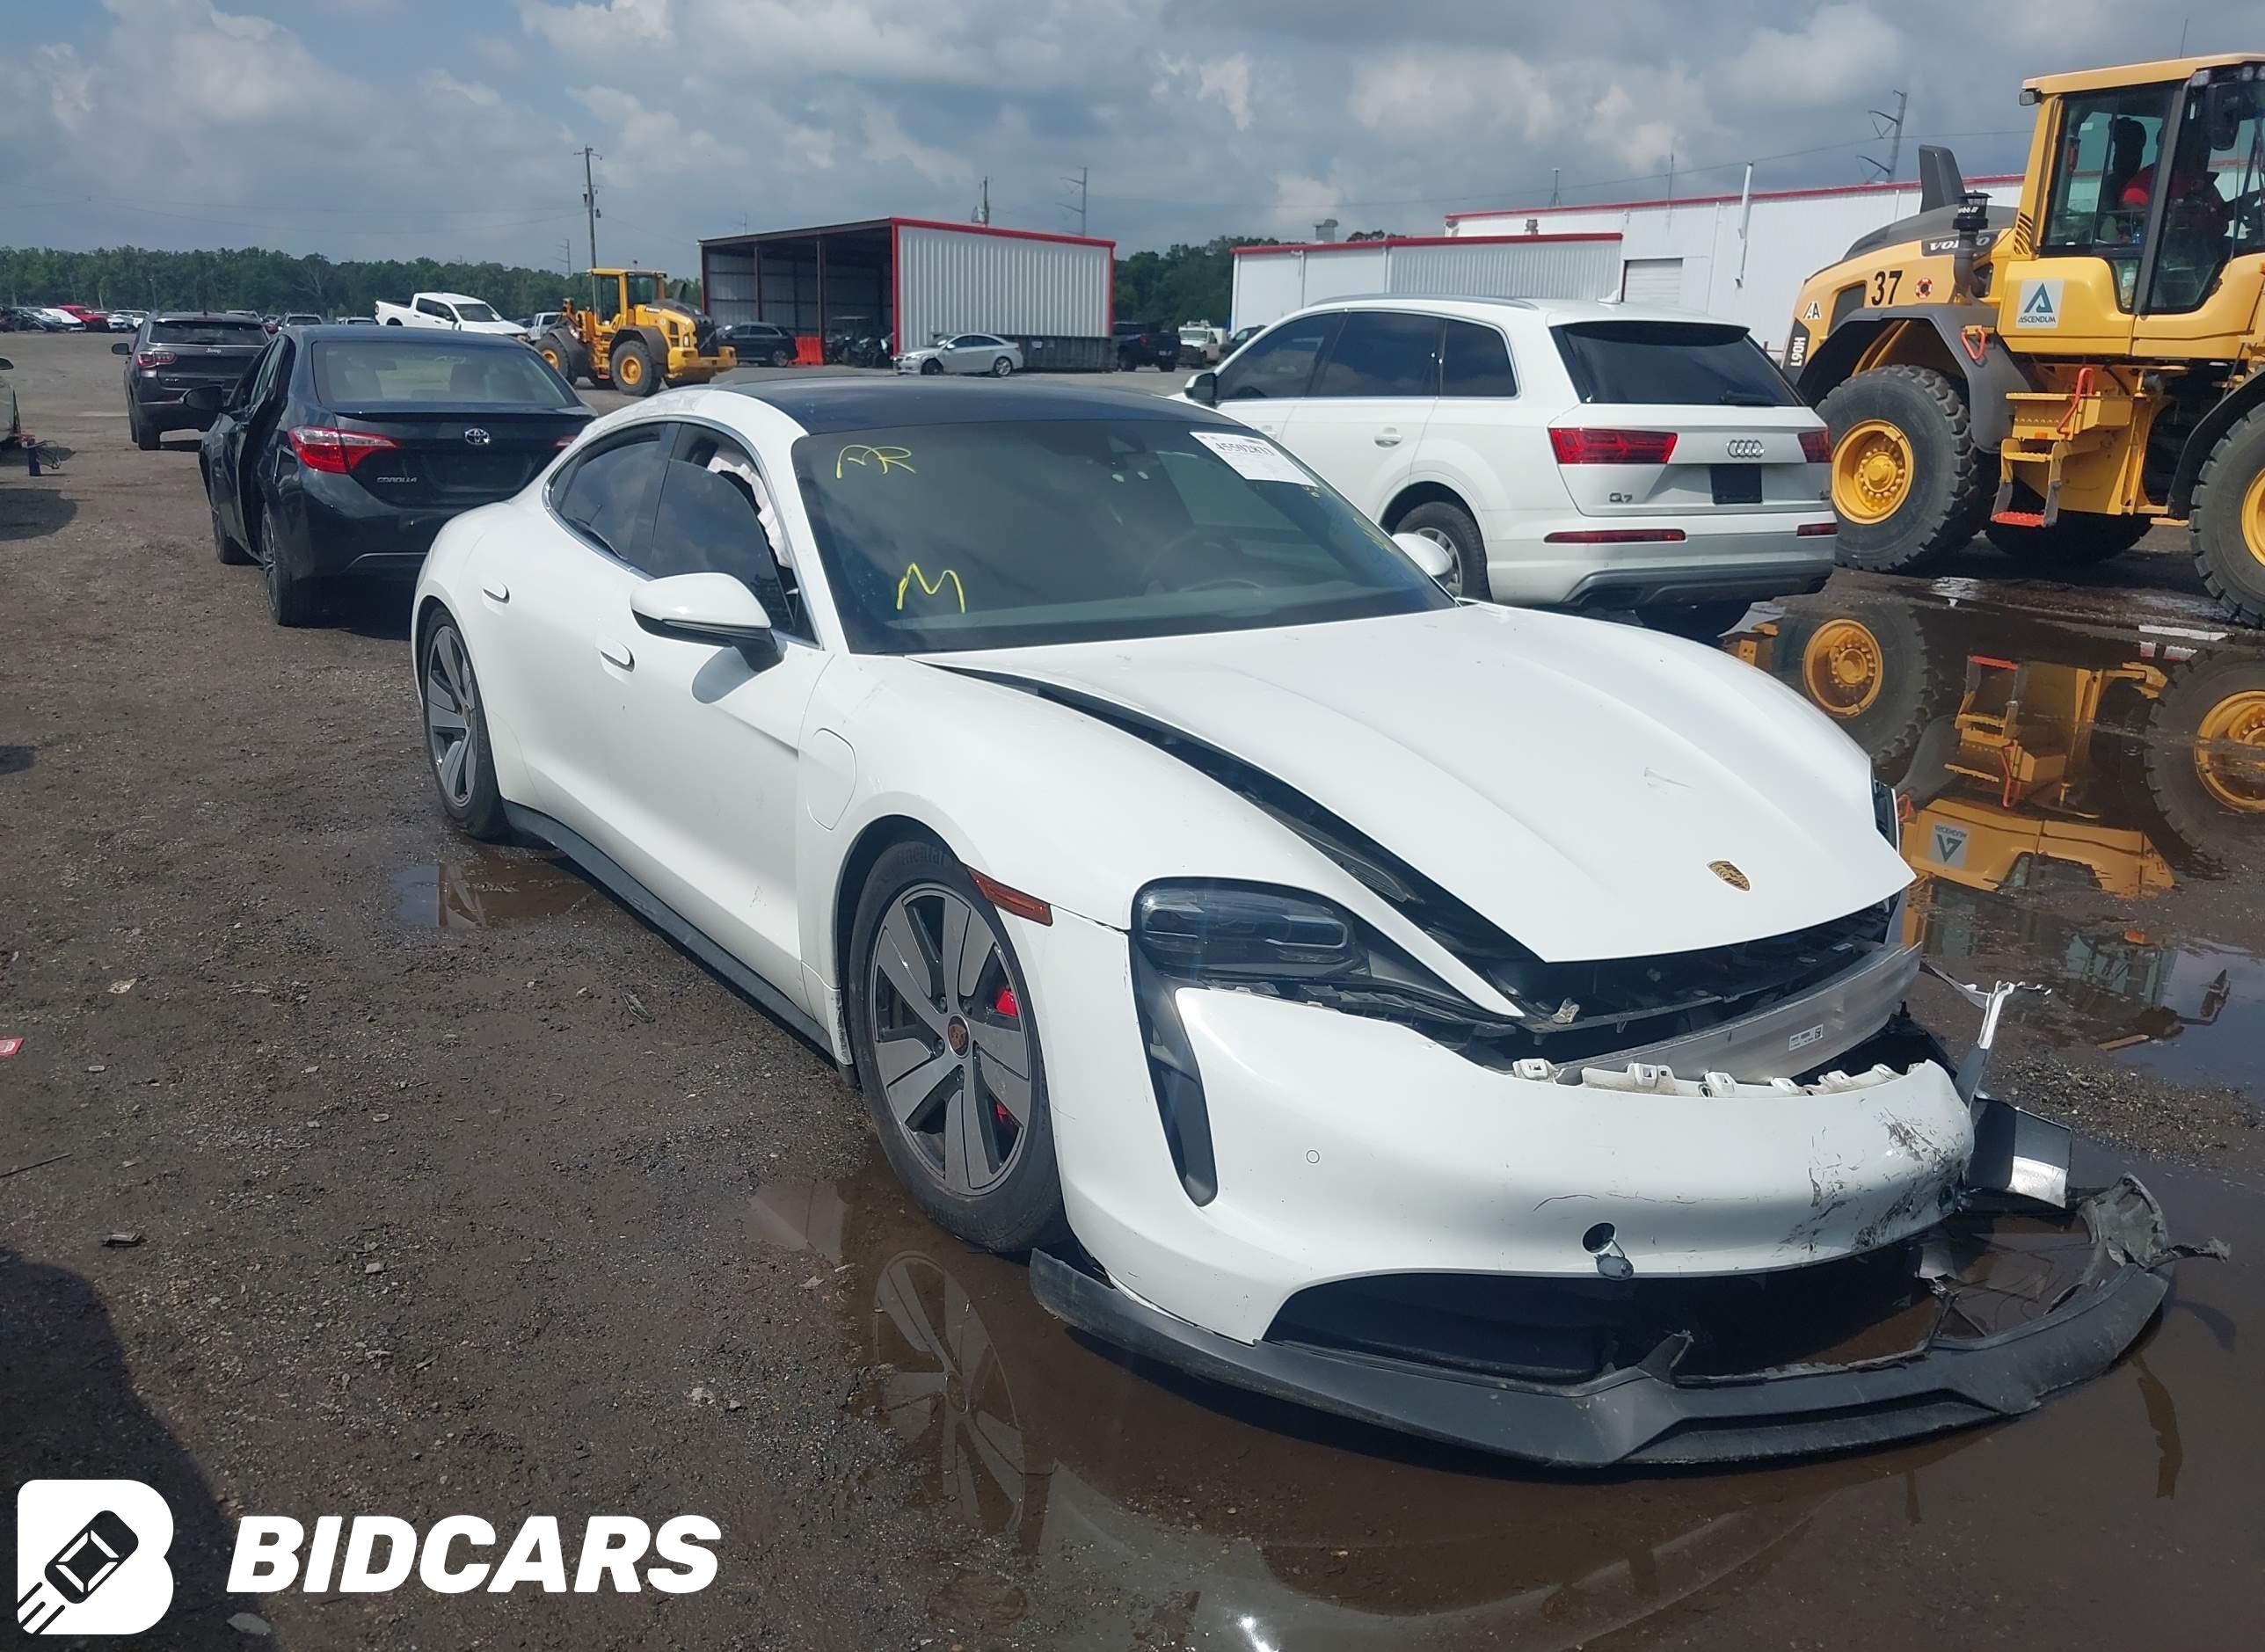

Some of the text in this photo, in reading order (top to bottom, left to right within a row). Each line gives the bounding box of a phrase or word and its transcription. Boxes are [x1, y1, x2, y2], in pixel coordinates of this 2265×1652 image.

[1871, 270, 1903, 306] 37
[1790, 337, 1806, 367] L90H
[1609, 492, 1633, 503] Q7
[897, 563, 965, 614] M
